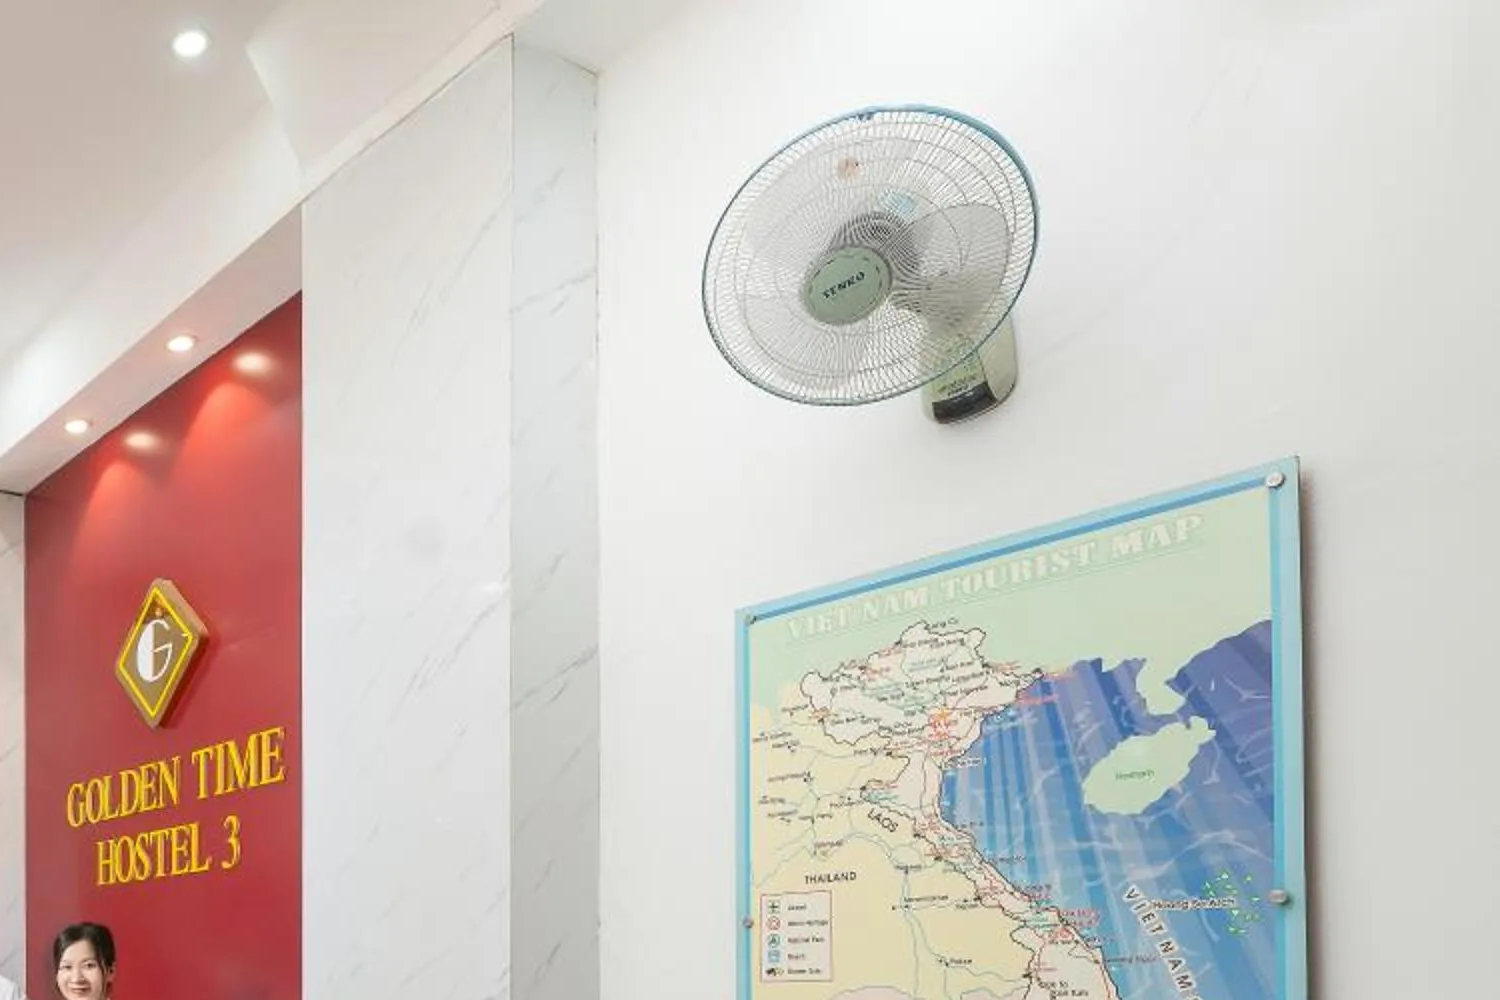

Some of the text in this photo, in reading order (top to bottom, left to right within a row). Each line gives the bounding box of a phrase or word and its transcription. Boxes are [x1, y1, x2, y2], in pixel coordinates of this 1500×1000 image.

[941, 541, 1097, 601] TOURIST
[1110, 513, 1205, 558] MAP
[136, 618, 174, 683] G
[66, 727, 286, 828] GOLDEN TIME
[96, 814, 242, 886] HOSTEL 3
[867, 808, 900, 833] LAOS
[803, 871, 858, 886] THAILAND
